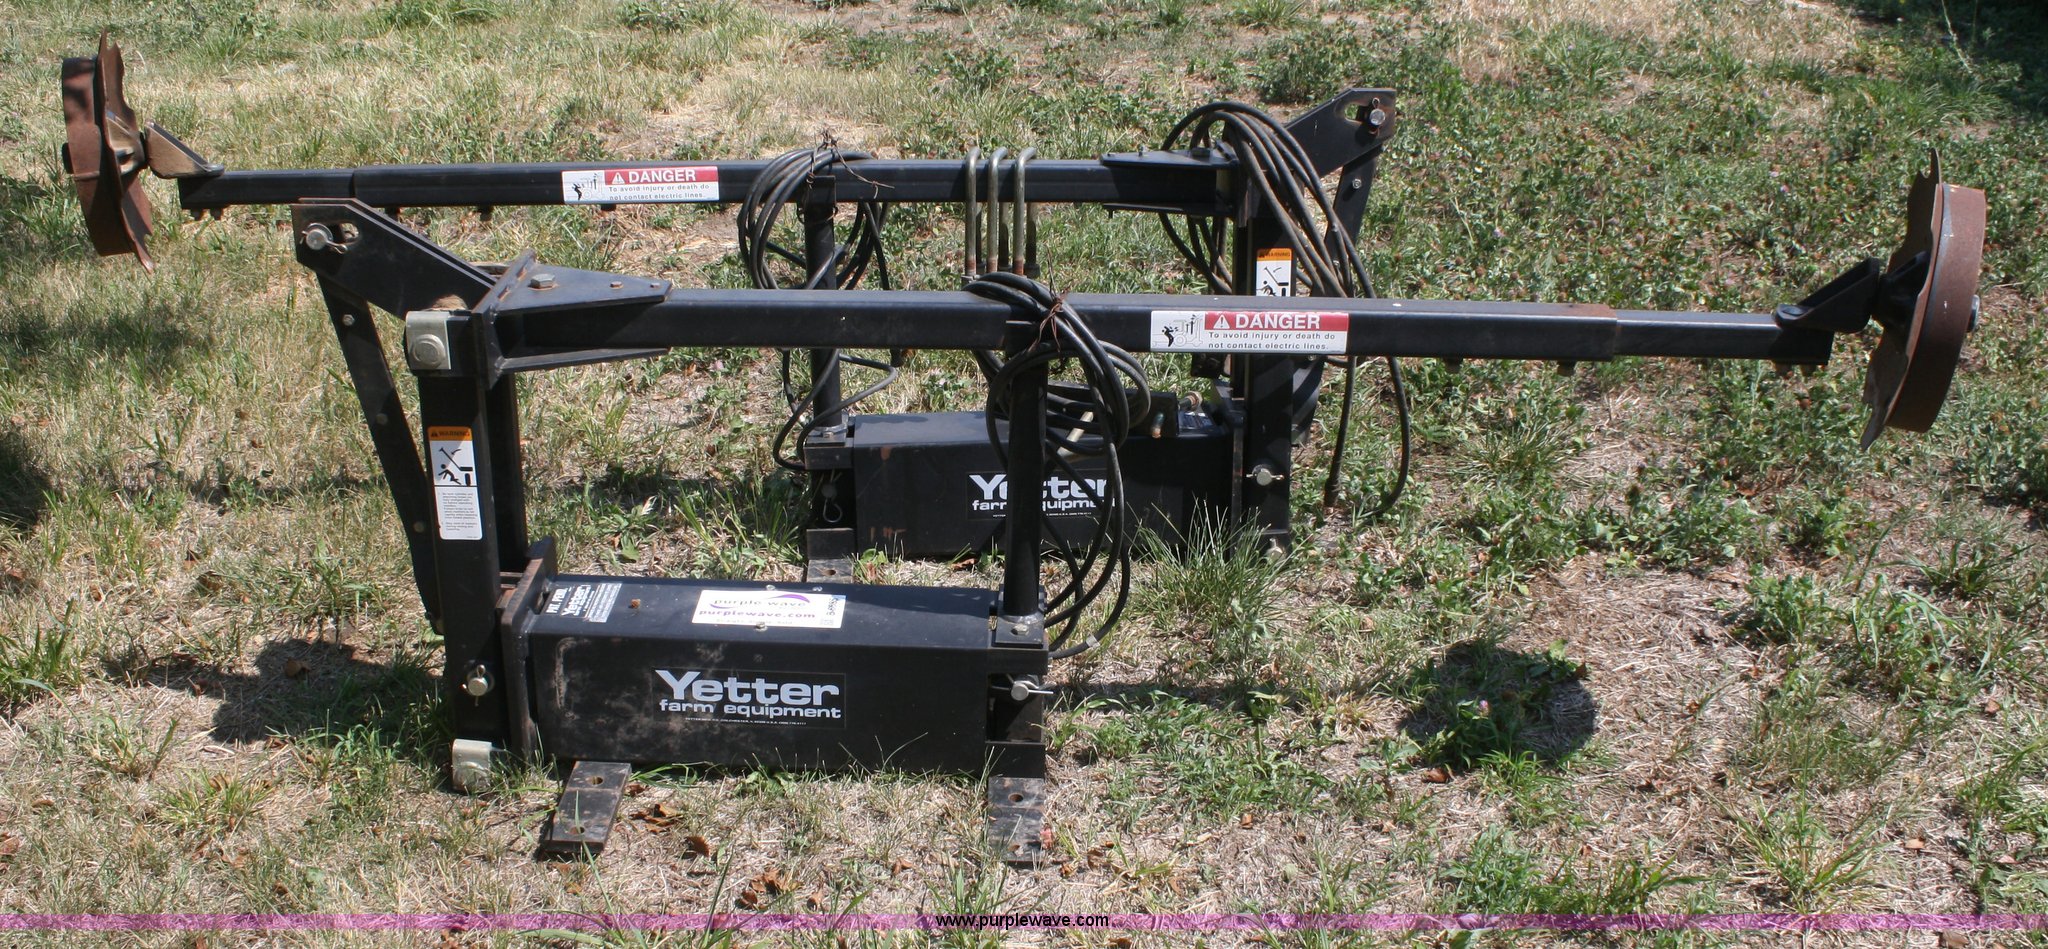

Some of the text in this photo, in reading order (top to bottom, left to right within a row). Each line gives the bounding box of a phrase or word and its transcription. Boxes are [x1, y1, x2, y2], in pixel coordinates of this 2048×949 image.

[629, 169, 696, 183] DANGER
[643, 185, 664, 193] injury
[1235, 314, 1320, 329] DANGER
[1252, 332, 1279, 341] injury
[969, 475, 1107, 500] Yter
[561, 587, 586, 615] Yetter
[699, 610, 815, 618] purplewave.com
[655, 669, 840, 706] Yetter
[659, 699, 841, 719] farm equipment
